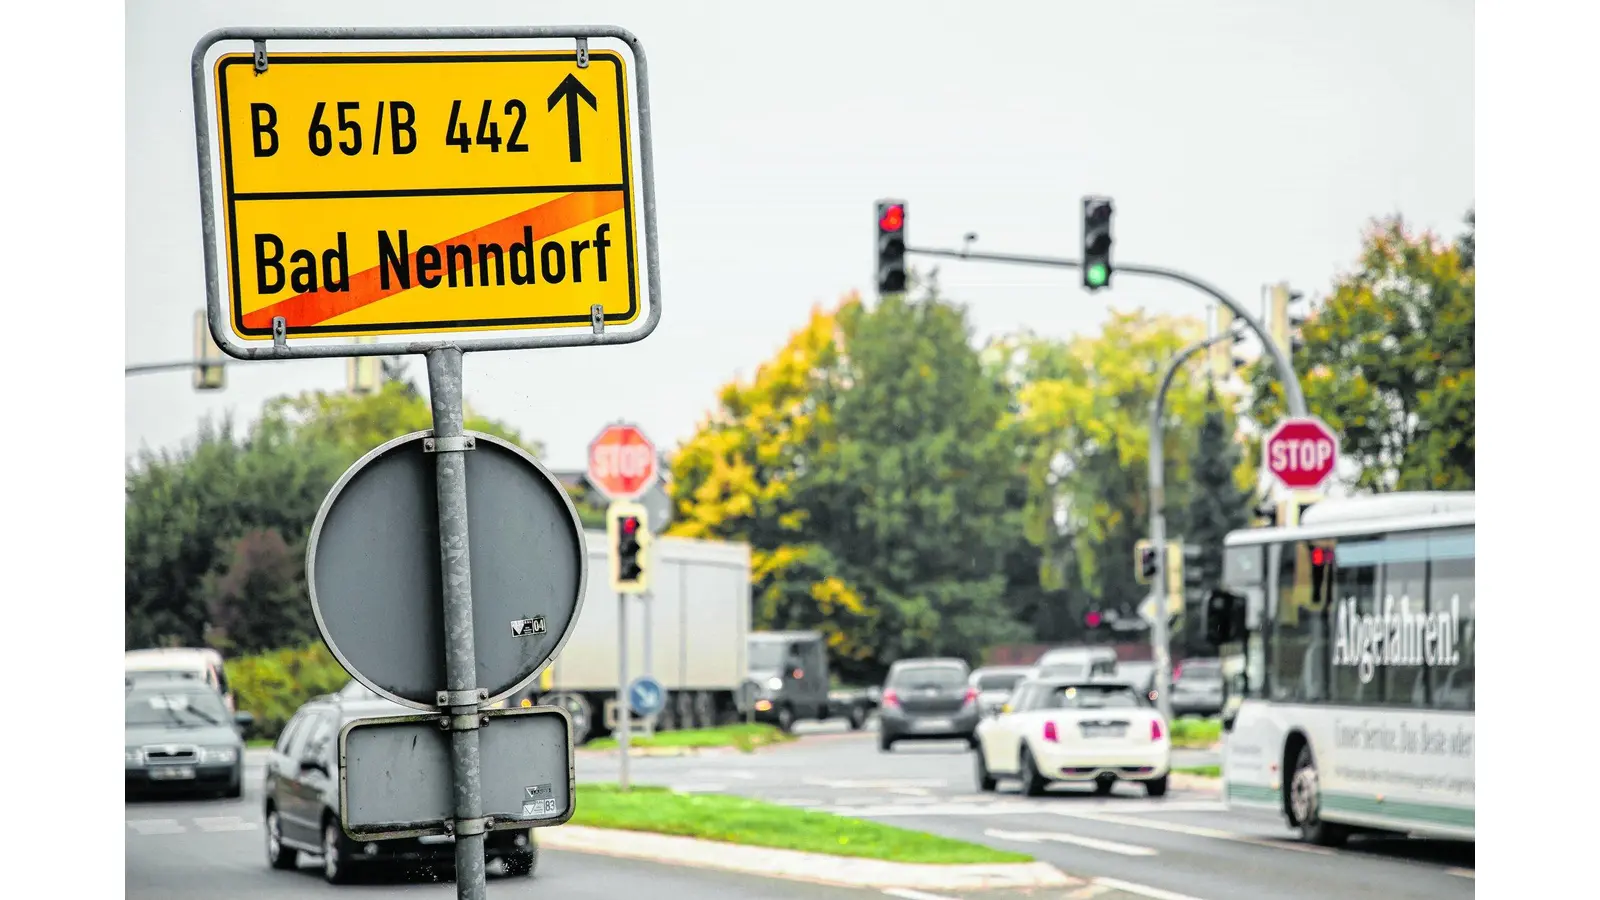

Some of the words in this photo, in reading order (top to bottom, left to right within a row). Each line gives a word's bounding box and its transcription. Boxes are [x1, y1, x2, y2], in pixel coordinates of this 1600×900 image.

[250, 102, 279, 157] B
[308, 101, 417, 156] 65/B
[445, 99, 529, 153] 442
[254, 231, 350, 294] Bad
[377, 223, 611, 290] Nenndorf
[594, 445, 651, 478] STOP
[1271, 438, 1331, 471] STOP
[1332, 594, 1459, 684] Abgefahren!
[545, 800, 555, 812] 83
